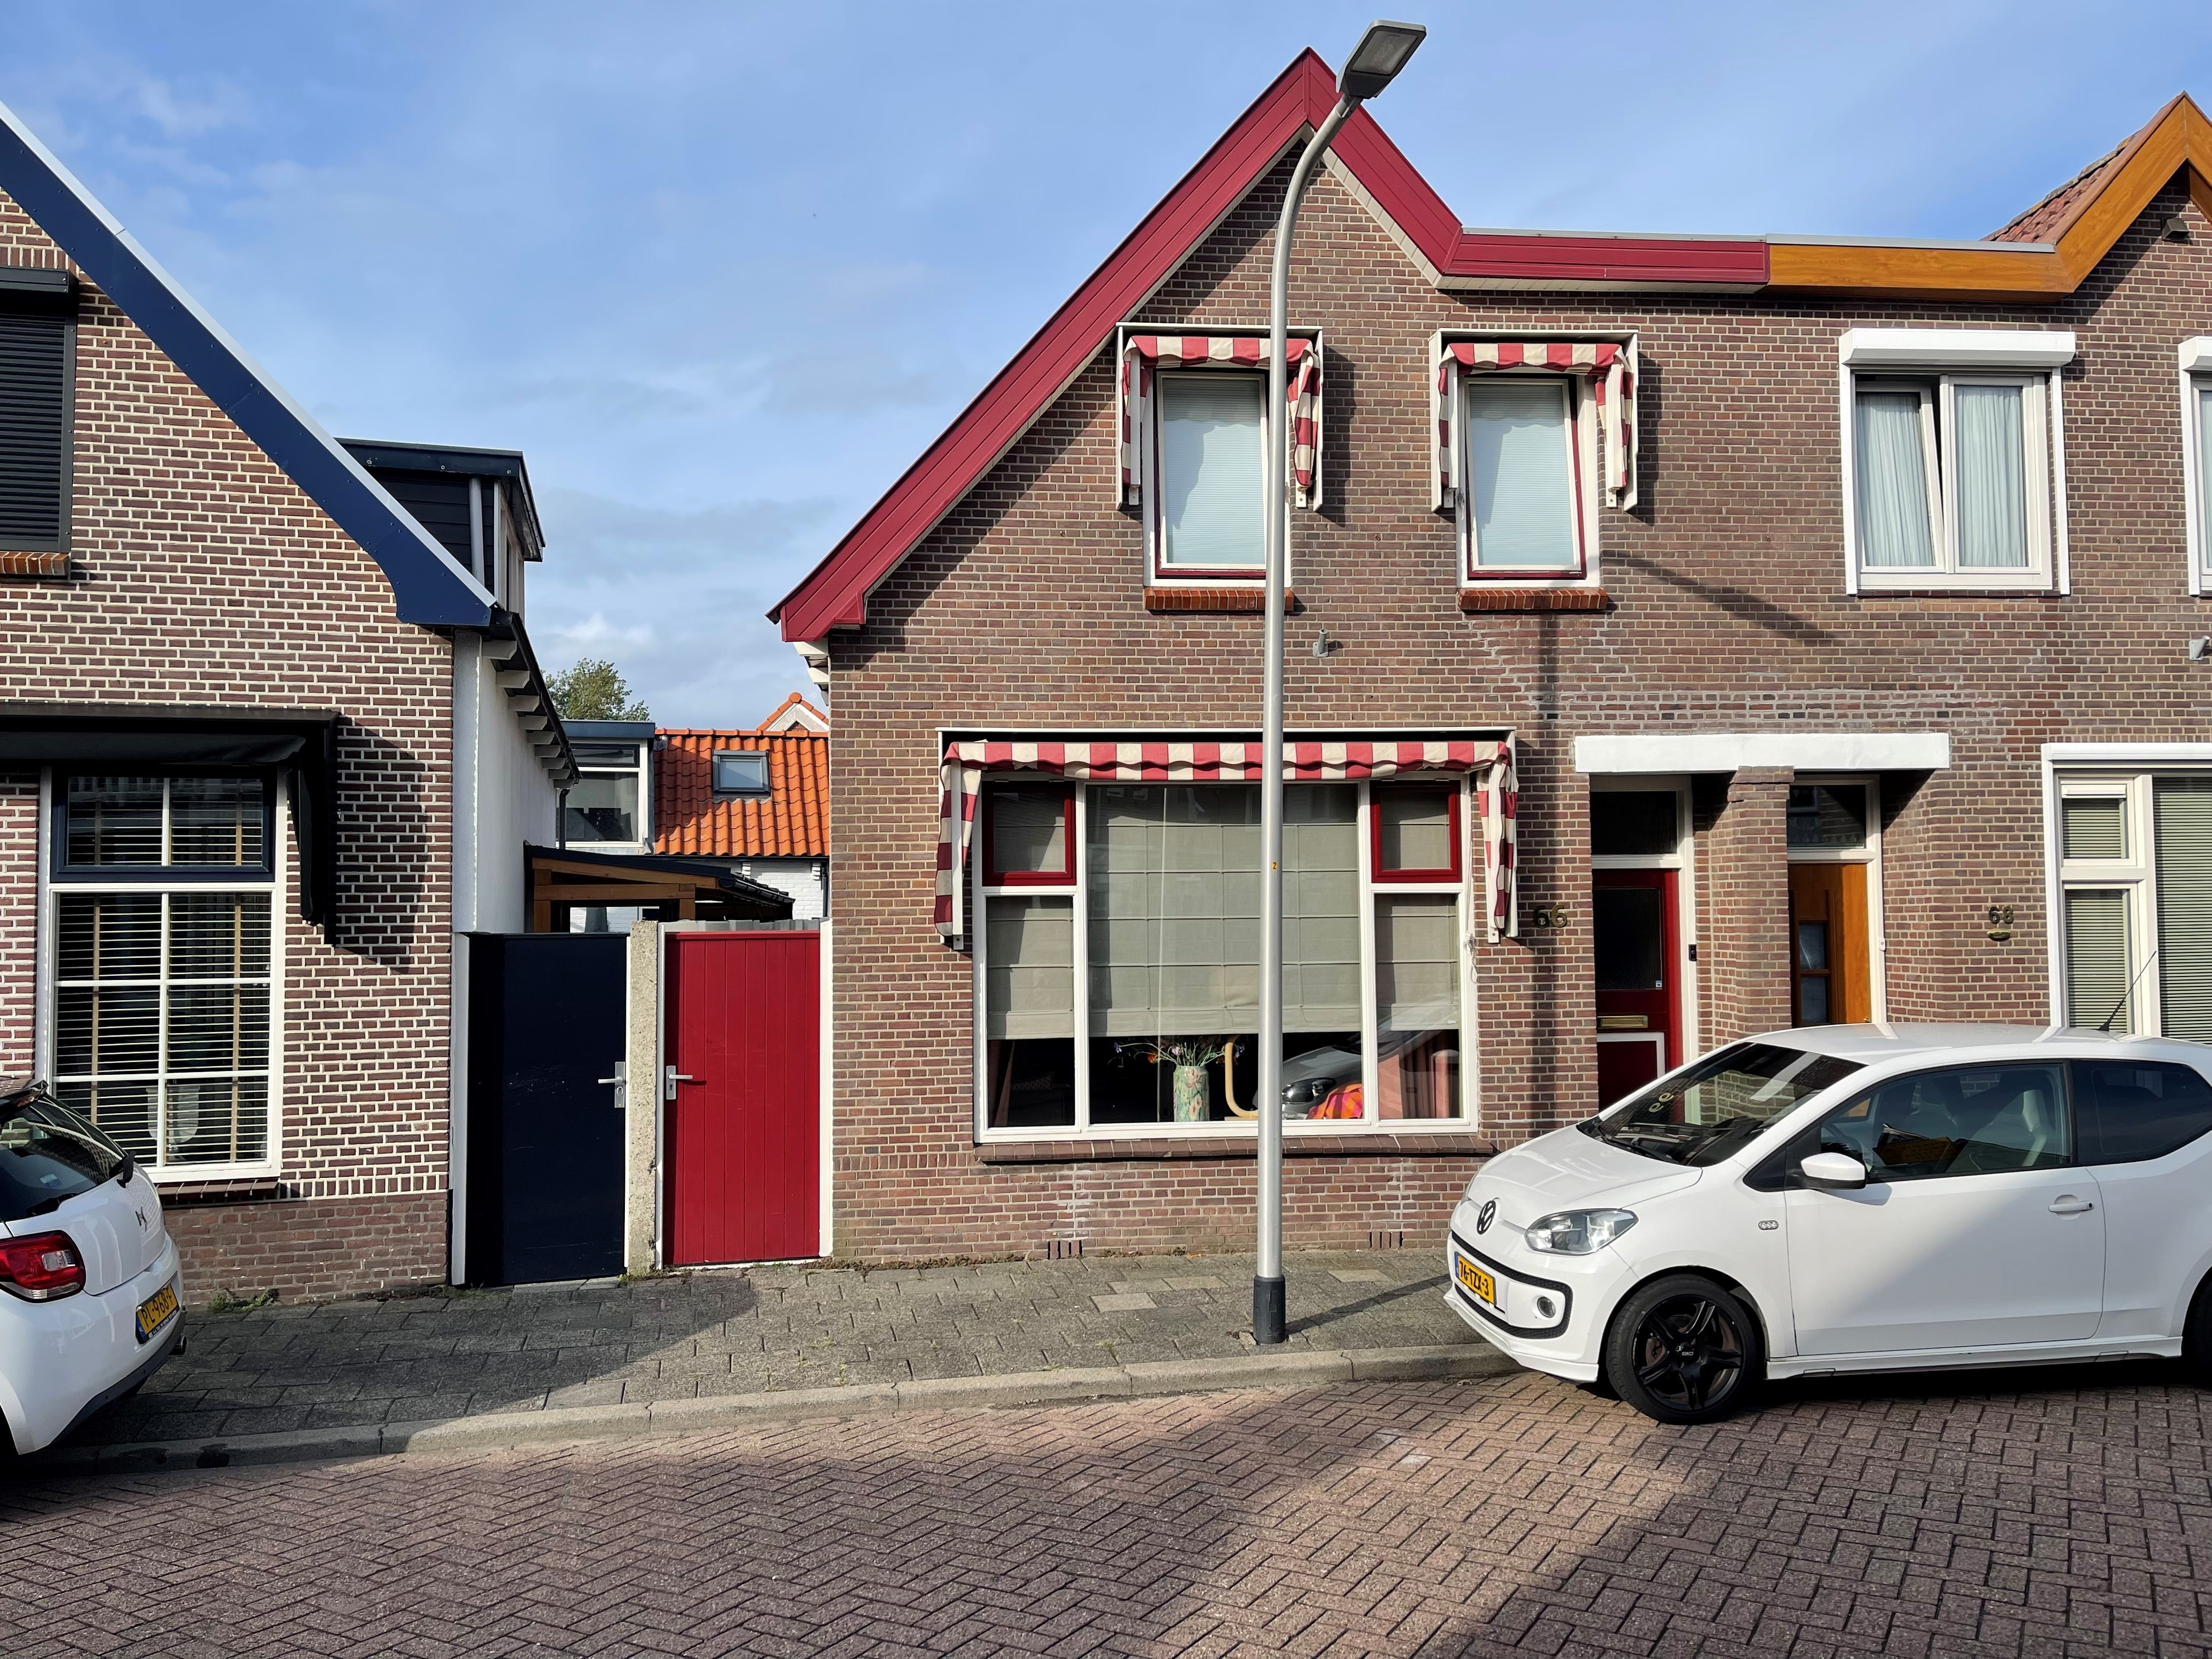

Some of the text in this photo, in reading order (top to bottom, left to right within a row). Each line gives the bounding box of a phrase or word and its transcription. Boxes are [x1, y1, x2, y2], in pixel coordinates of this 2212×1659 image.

[1272, 861, 1277, 870] 2
[1534, 904, 1567, 929] 66
[1988, 906, 2014, 924] 68
[1459, 1260, 1489, 1296] 76-TZX-3
